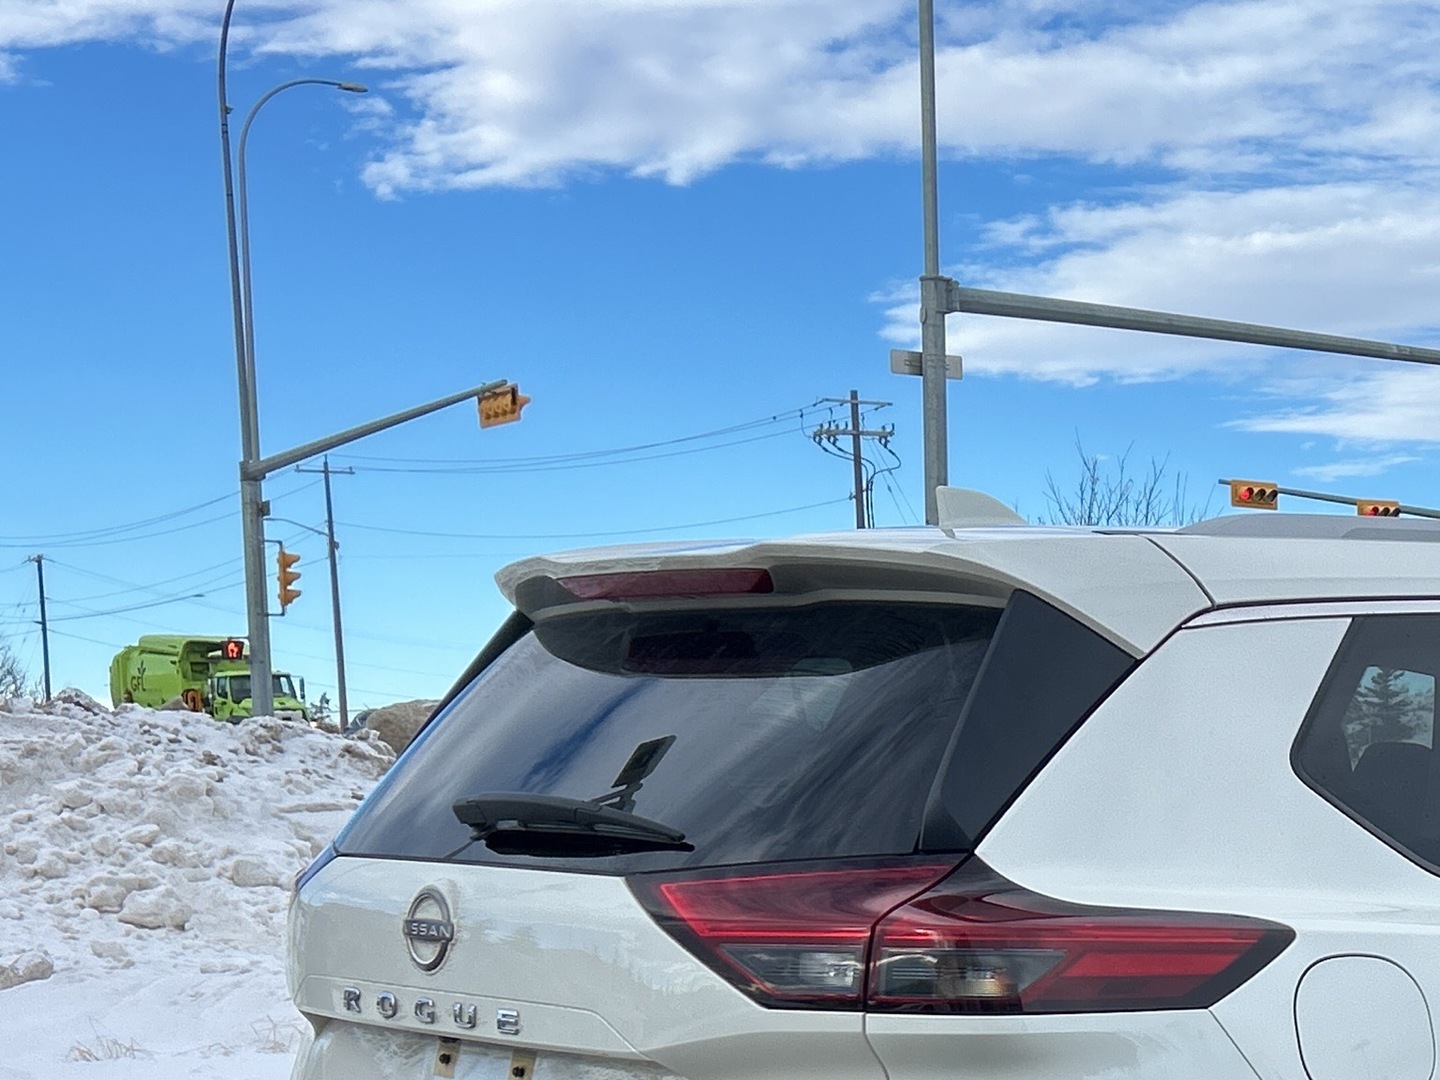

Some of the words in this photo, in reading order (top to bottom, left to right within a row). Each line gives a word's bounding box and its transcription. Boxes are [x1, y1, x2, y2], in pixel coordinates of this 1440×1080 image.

[131, 672, 147, 692] GFL
[404, 921, 452, 938] SSAN
[344, 986, 520, 1036] ROGUE
